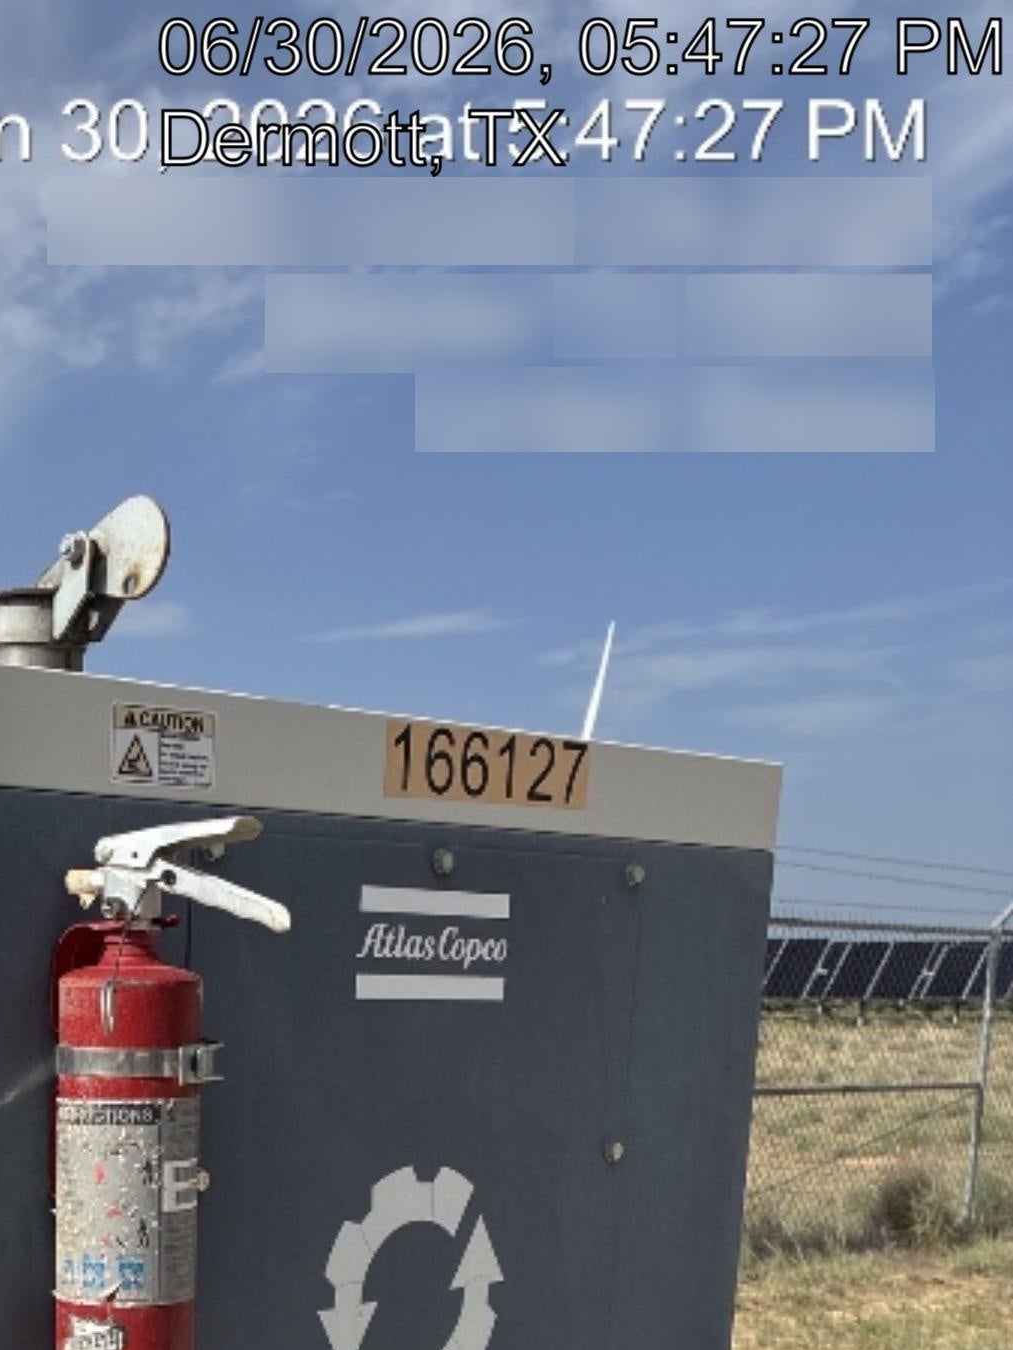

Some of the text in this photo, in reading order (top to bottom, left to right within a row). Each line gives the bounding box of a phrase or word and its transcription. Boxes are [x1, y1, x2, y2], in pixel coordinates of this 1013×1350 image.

[139, 710, 205, 734] CAUTION
[392, 722, 589, 805] 166127
[356, 922, 508, 970] Atlas Copco
